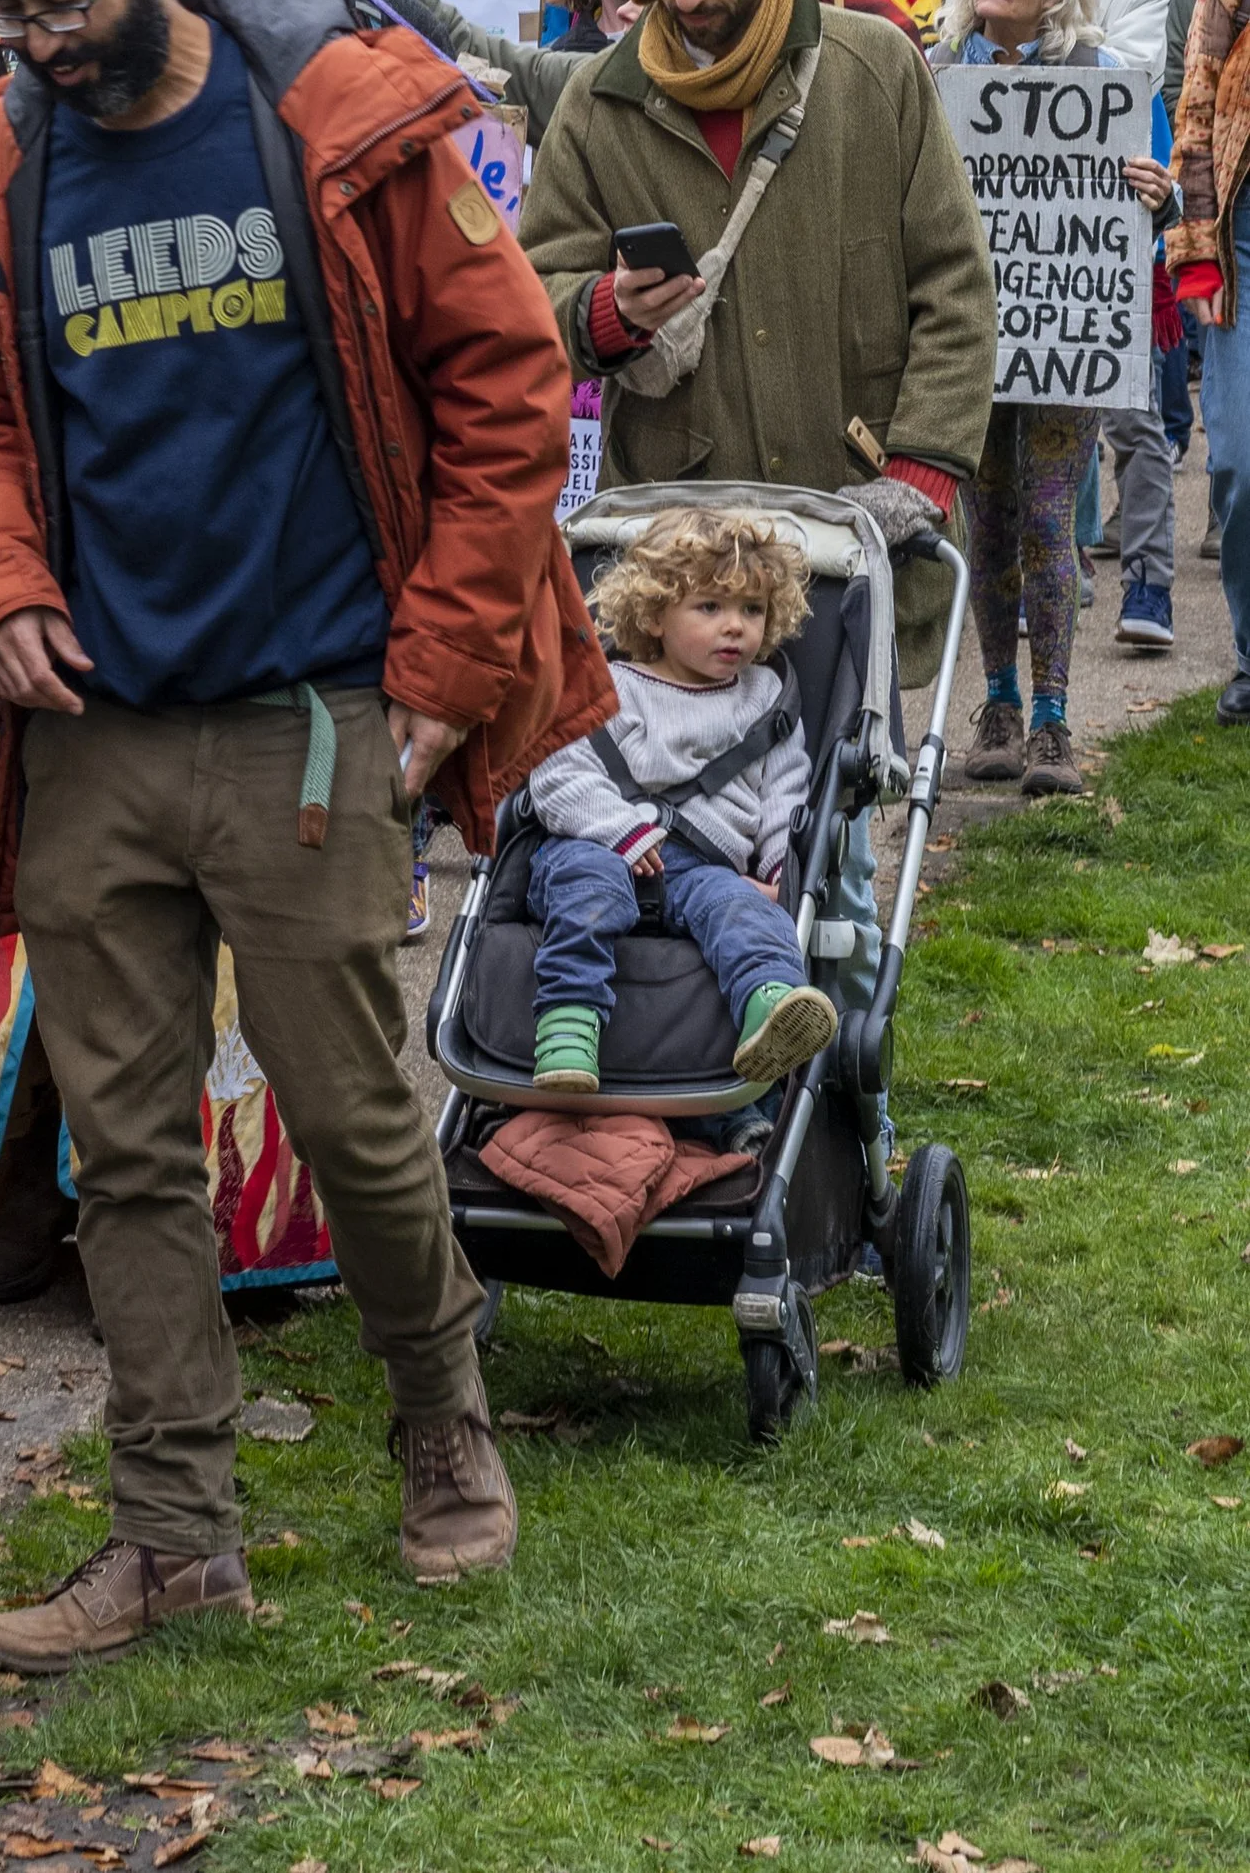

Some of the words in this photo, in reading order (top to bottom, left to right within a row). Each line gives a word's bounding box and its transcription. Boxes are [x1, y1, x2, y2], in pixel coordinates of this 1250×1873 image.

[970, 78, 1134, 145] STOP
[50, 207, 284, 316] LEEDS
[980, 209, 1129, 262] EALING
